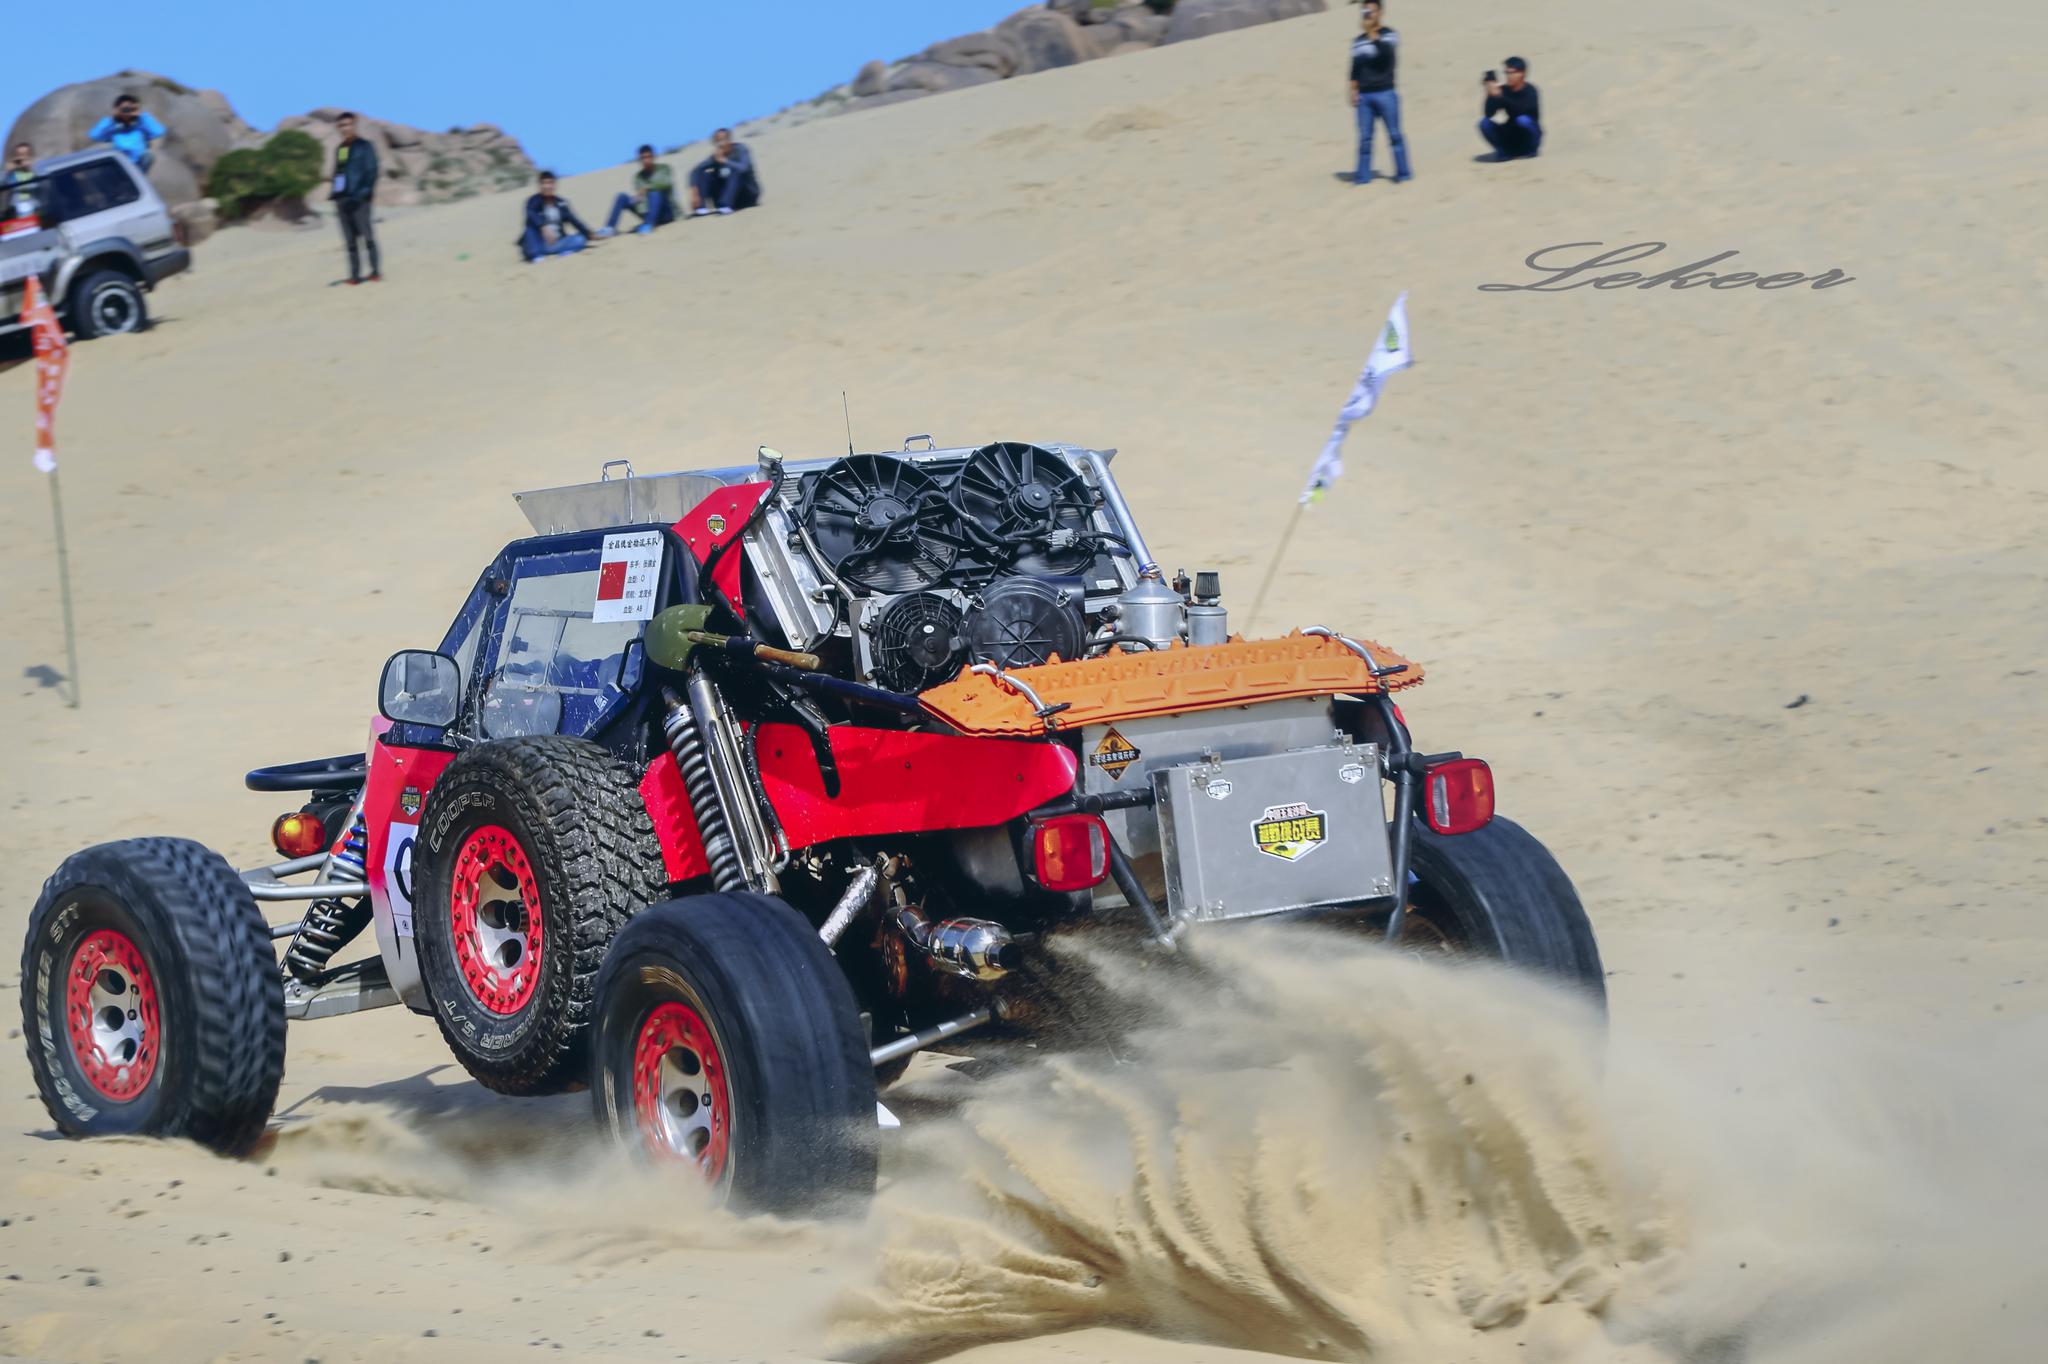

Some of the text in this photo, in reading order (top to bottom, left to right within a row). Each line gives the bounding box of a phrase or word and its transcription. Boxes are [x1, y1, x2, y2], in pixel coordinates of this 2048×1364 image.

[429, 791, 495, 853] COOPER
[1258, 817, 1322, 844] 越野挑战赛
[49, 901, 81, 945] STT
[443, 999, 477, 1039] S/T
